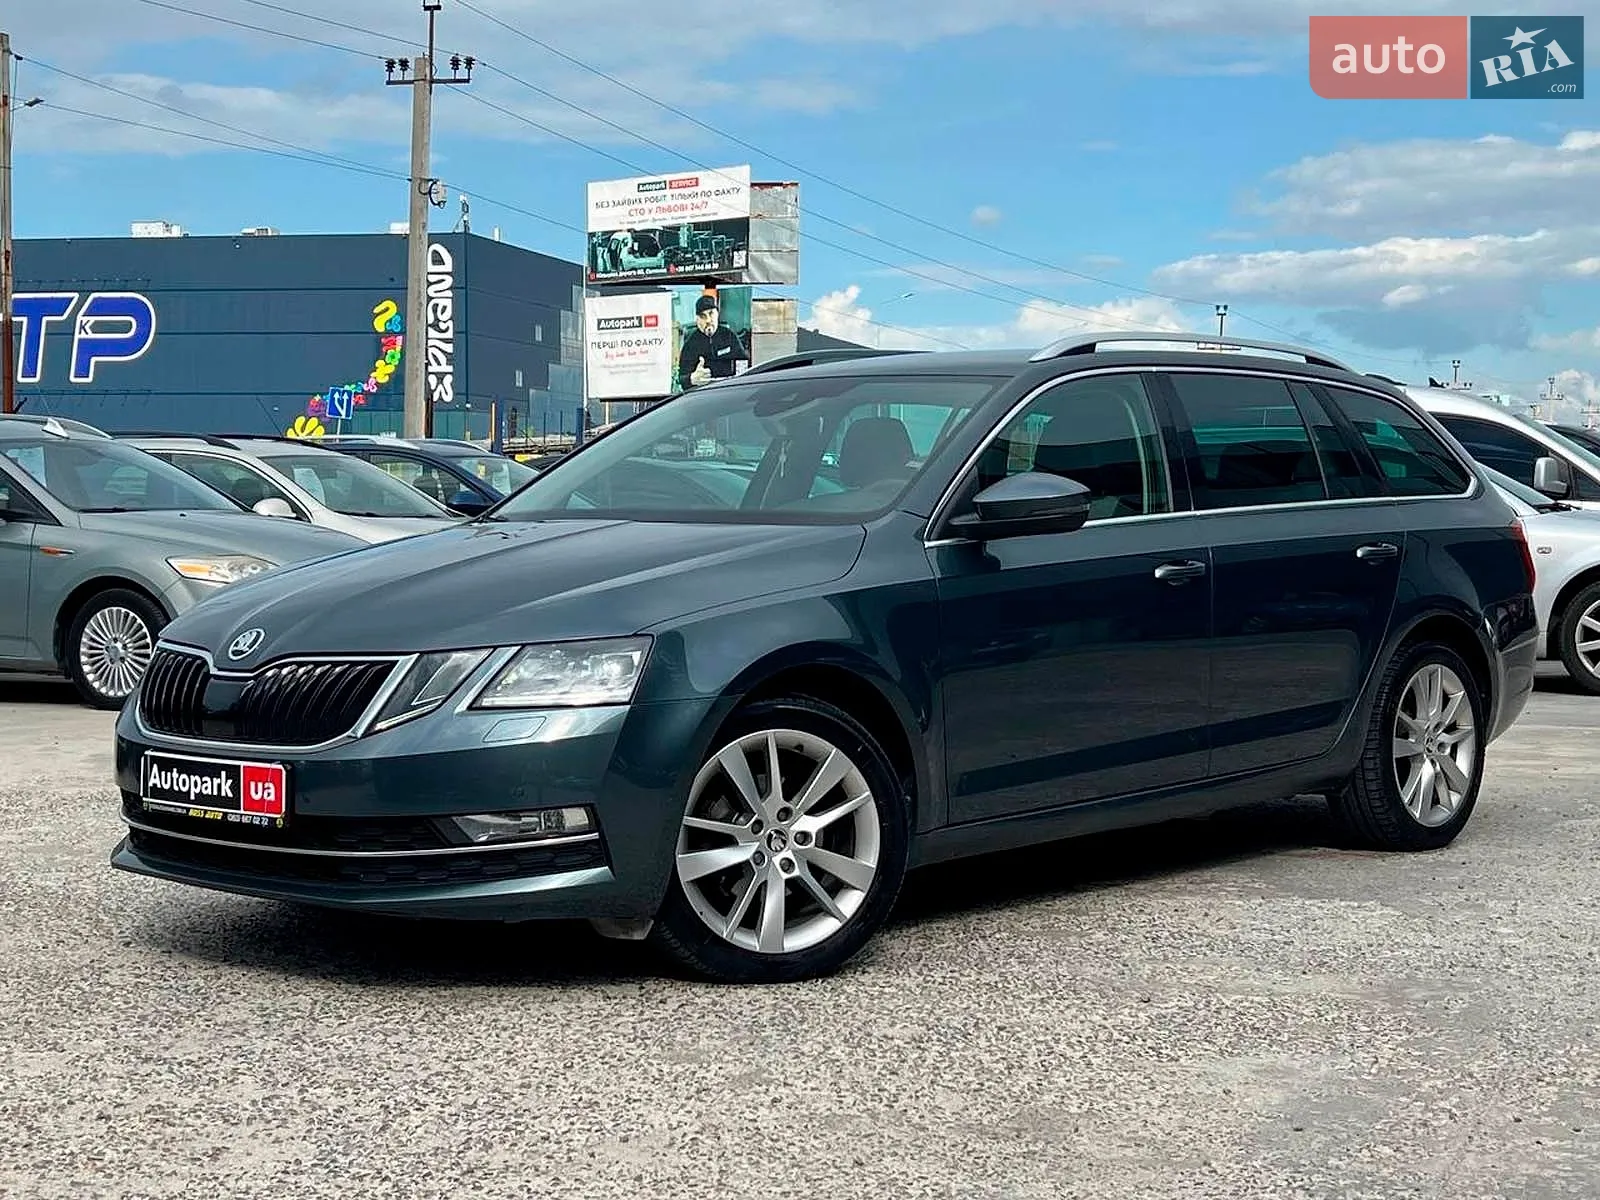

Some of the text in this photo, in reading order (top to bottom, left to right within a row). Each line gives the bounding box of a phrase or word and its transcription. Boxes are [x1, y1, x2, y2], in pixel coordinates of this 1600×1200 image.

[595, 201, 610, 210] БЕЗ
[700, 190, 713, 199] ПО
[714, 187, 741, 197] ФАКТУ
[628, 201, 709, 217] СТО У ЛЬВОВІ 24/7
[599, 318, 641, 330] Autopark
[591, 337, 664, 350] ПЕРШІ ПО ФАКТУ
[149, 763, 276, 801] Autopark ua
